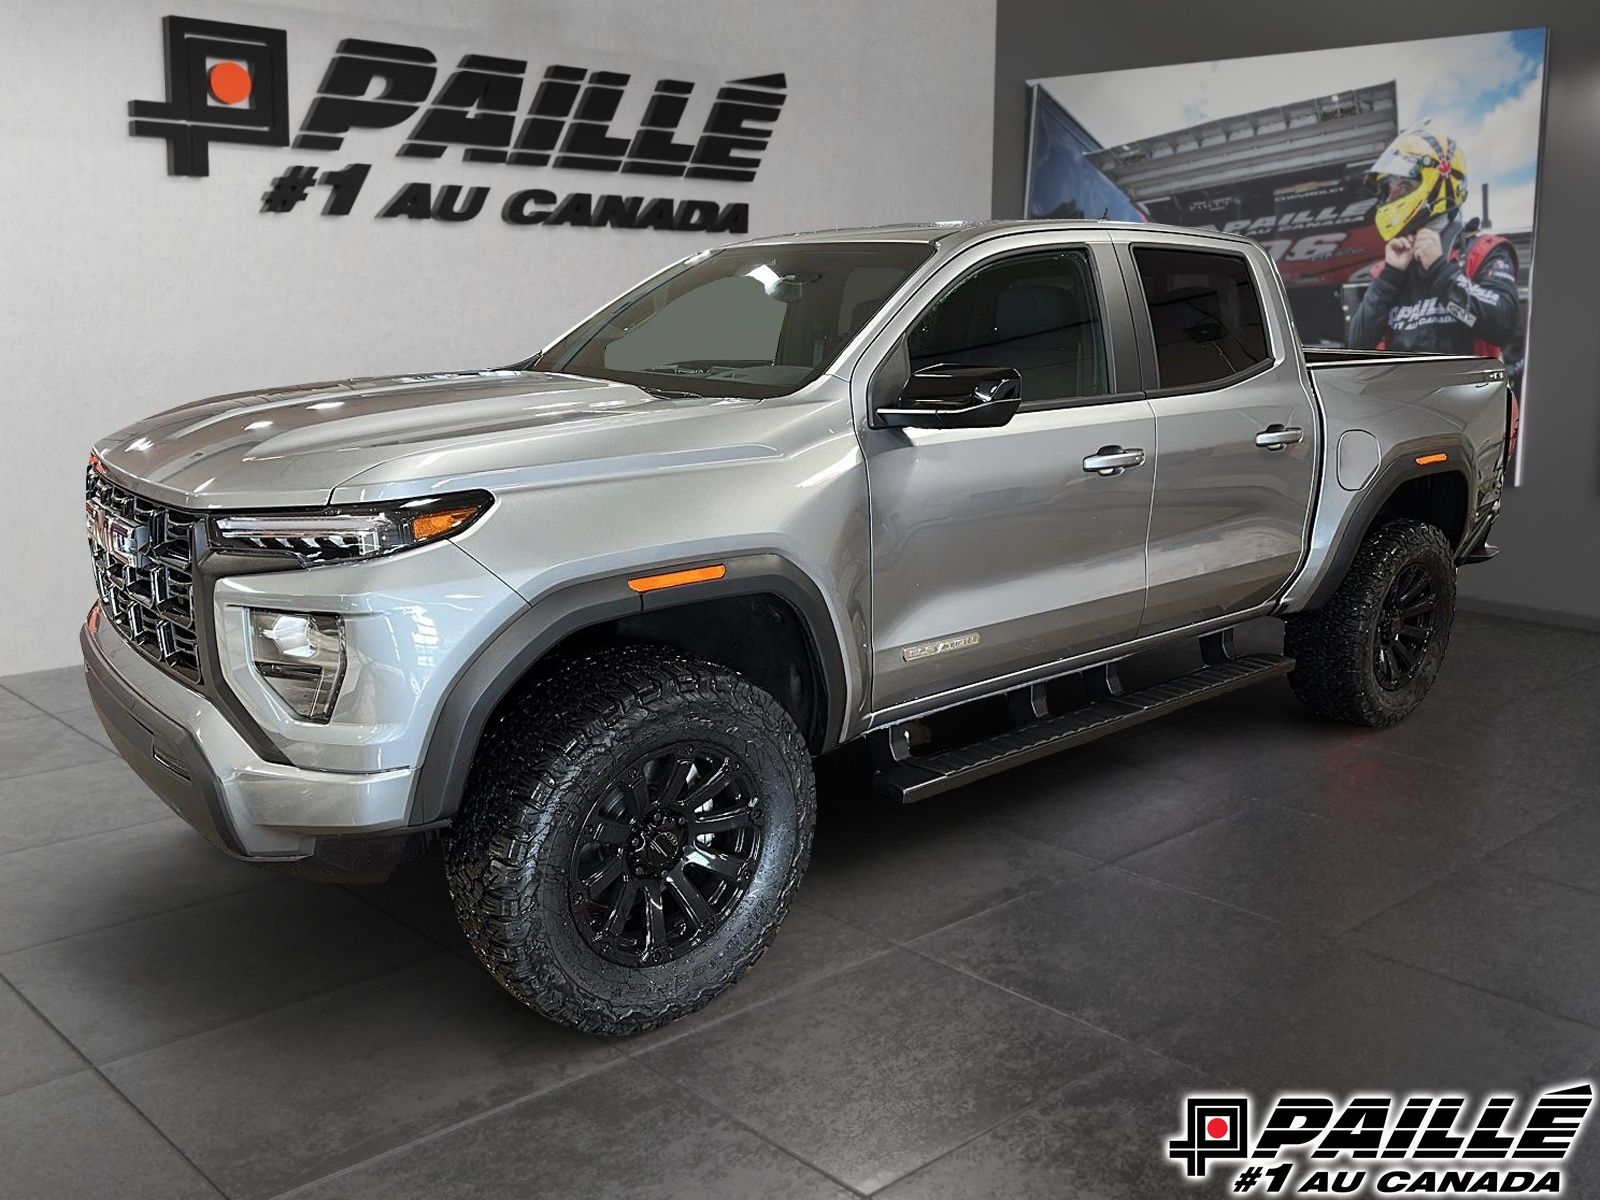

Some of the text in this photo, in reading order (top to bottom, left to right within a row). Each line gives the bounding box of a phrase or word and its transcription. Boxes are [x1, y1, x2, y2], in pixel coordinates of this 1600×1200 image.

[291, 38, 787, 182] PAILLÉ
[260, 164, 749, 233] #1 AU CANADA
